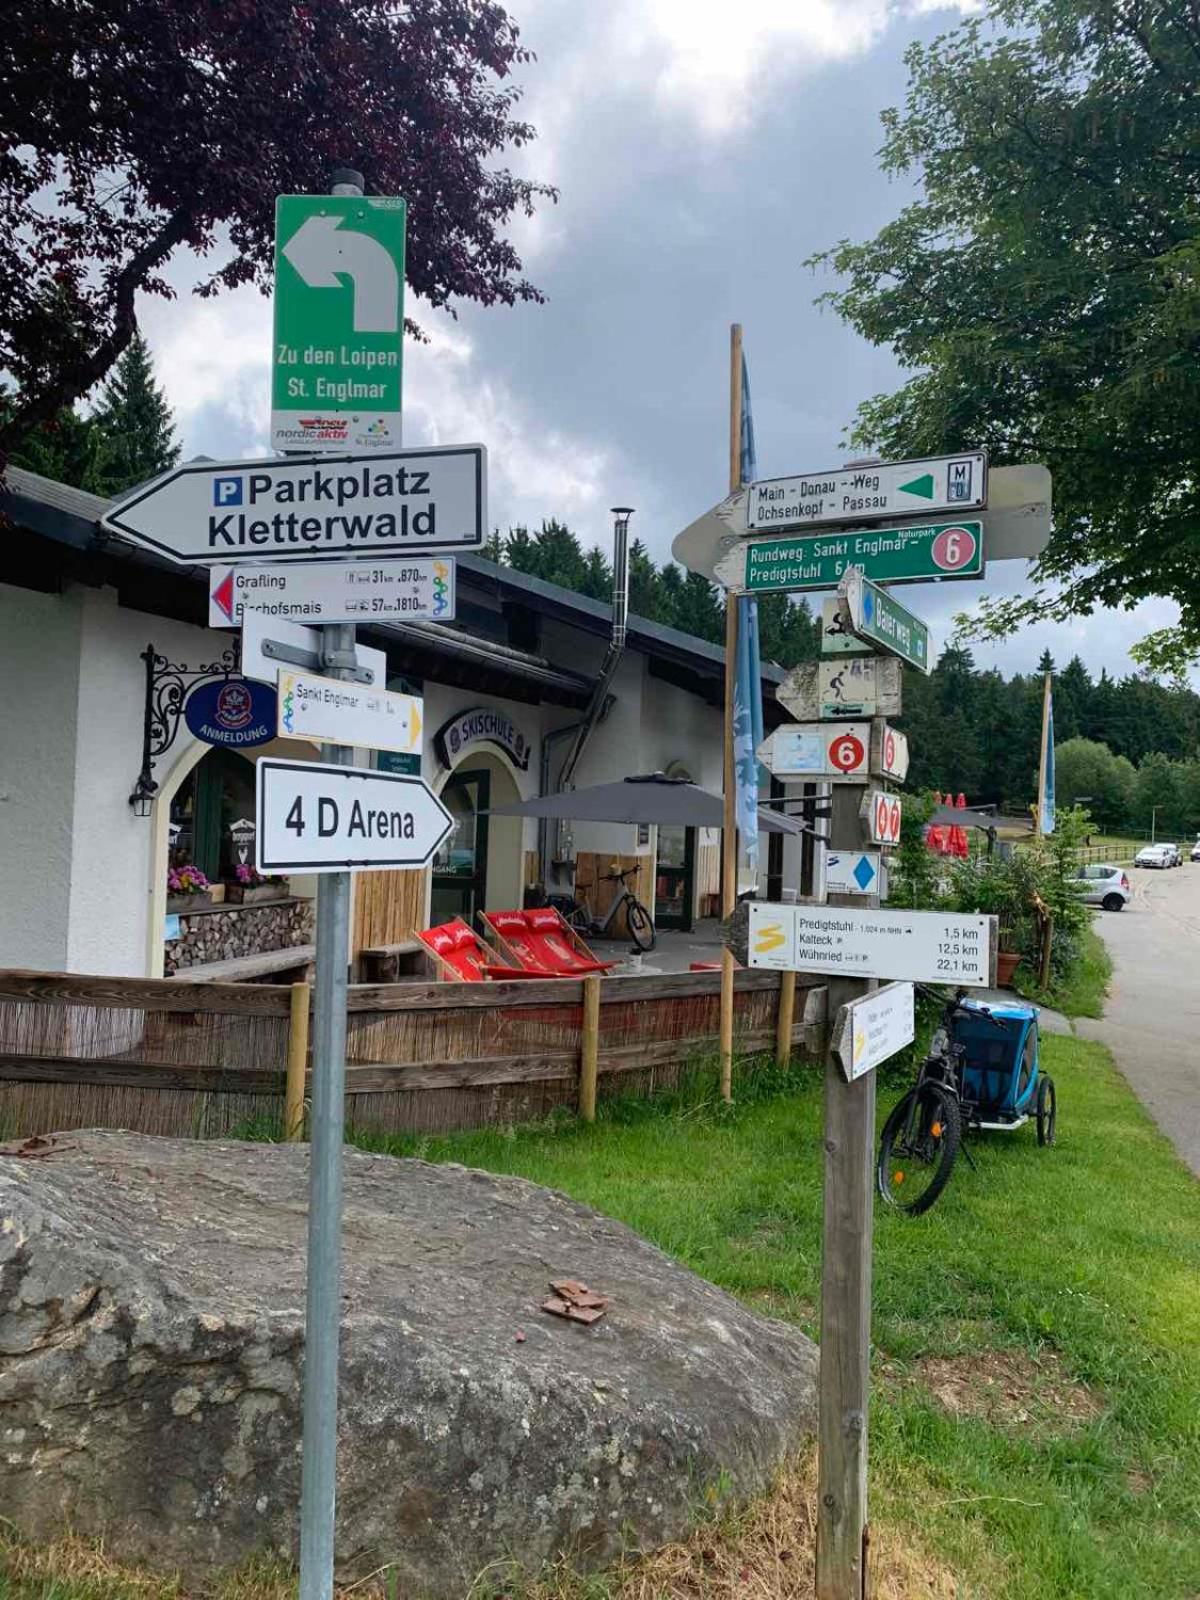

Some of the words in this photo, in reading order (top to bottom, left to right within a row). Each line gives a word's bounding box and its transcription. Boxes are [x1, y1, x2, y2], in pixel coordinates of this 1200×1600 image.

[277, 345, 297, 364] Zu
[304, 345, 334, 365] den
[341, 346, 398, 370] Loipen
[288, 377, 309, 397] St.
[316, 378, 388, 402] Englmar
[955, 465, 965, 481] M
[248, 467, 430, 507] Parkplatz
[758, 486, 785, 502] Main
[801, 480, 836, 497] Donau
[854, 474, 880, 491] Weg
[758, 501, 824, 521] Ochsenkopf
[843, 494, 887, 511] Passau
[208, 502, 437, 547] Kletterwald
[898, 527, 936, 540] Naturpark
[813, 541, 848, 558] Sankt
[855, 538, 907, 557] Englmar
[944, 534, 960, 564] 6
[236, 574, 286, 590] Grafling
[750, 562, 822, 583] Predigtstuhl
[835, 561, 843, 576] 6
[236, 601, 322, 616] Bhofsmais
[296, 683, 322, 702] Sankt
[324, 689, 359, 708] Englmar
[199, 724, 268, 743] ANMELDUNG
[462, 714, 515, 743] SKISCHULE
[838, 742, 855, 766] 6
[886, 742, 893, 760] 6
[285, 795, 305, 837] 4
[318, 797, 339, 837] D
[348, 799, 415, 839] Arena
[799, 918, 853, 932] Predigtstuhl
[944, 927, 960, 940] 1,5
[962, 928, 978, 940] km
[799, 934, 833, 946] Kalteck
[938, 943, 960, 956] 12,5
[962, 943, 978, 956] km
[799, 948, 842, 962] Wühnried
[937, 959, 958, 971] 22,1
[962, 959, 978, 972] km
